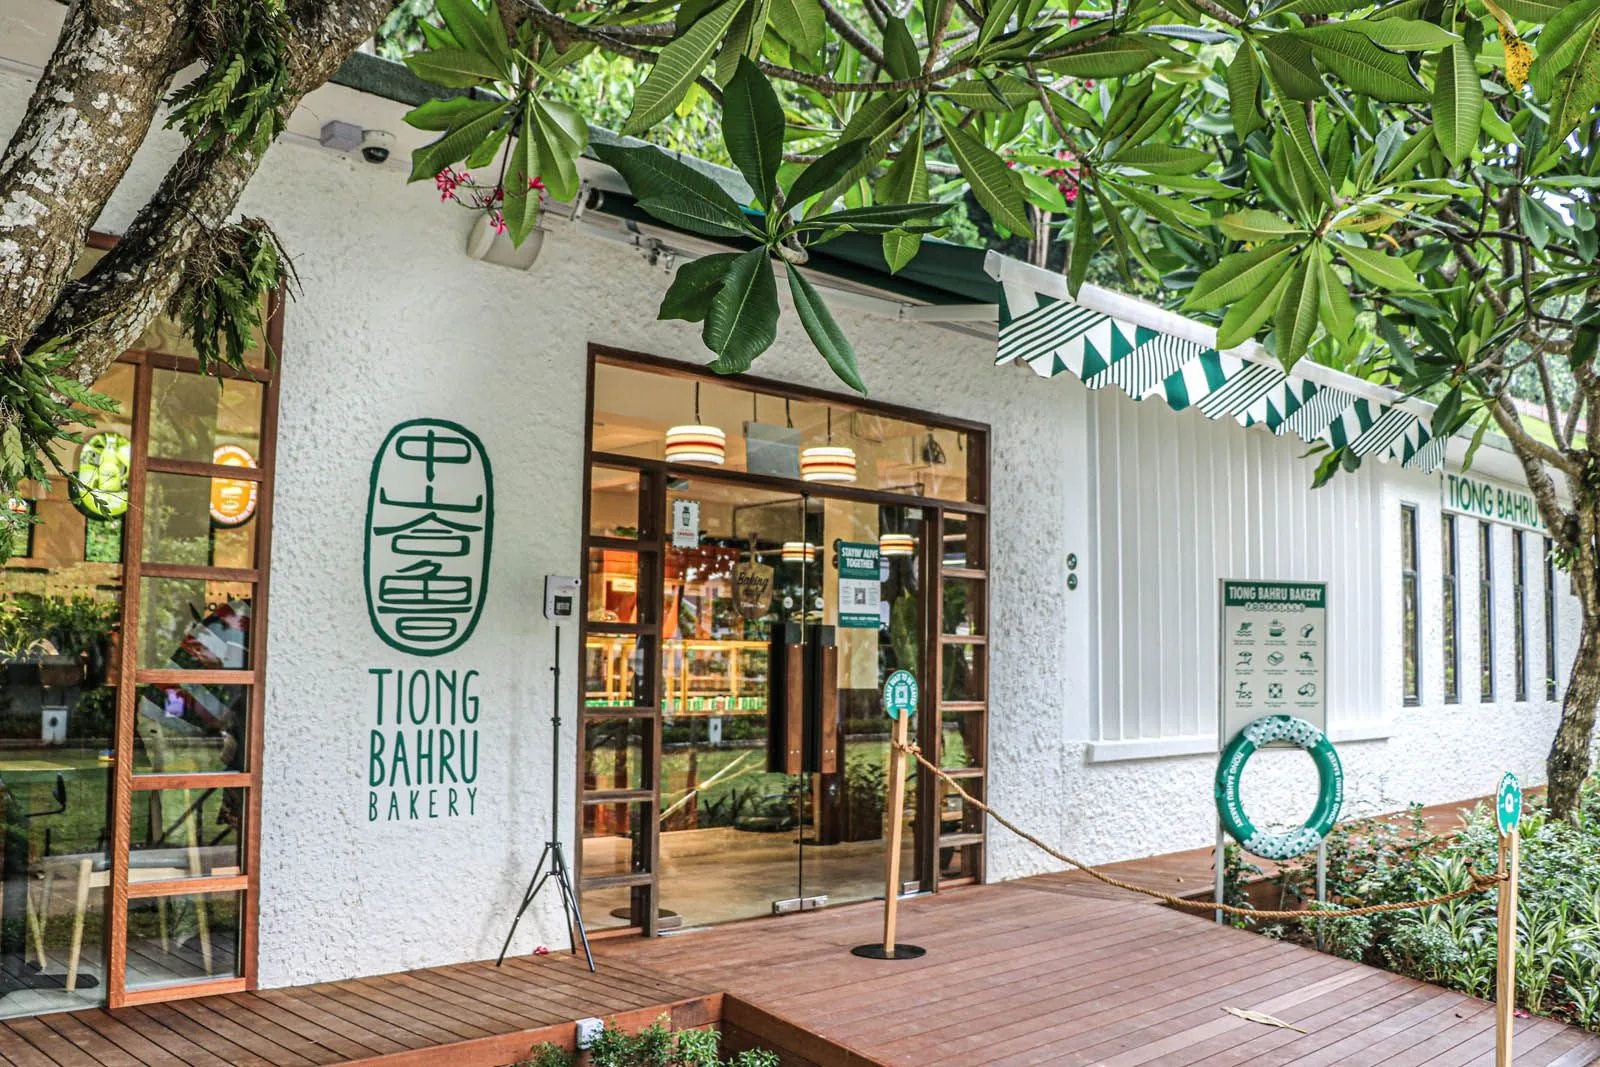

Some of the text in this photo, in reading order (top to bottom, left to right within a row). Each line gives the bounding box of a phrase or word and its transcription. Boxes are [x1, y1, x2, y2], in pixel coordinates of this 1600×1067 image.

[1447, 474, 1494, 515] TIONG
[1497, 489, 1539, 527] BAHRU
[846, 558, 874, 569] TOGETHER
[863, 548, 879, 559] ALIVE
[1229, 586, 1322, 601] TIONG BAHRU BAKERY
[368, 668, 480, 726] TIONG
[369, 728, 479, 787] BAHRU
[368, 787, 478, 822] BAKERY
[1226, 752, 1244, 827] TIONG BAHRU BAKERY
